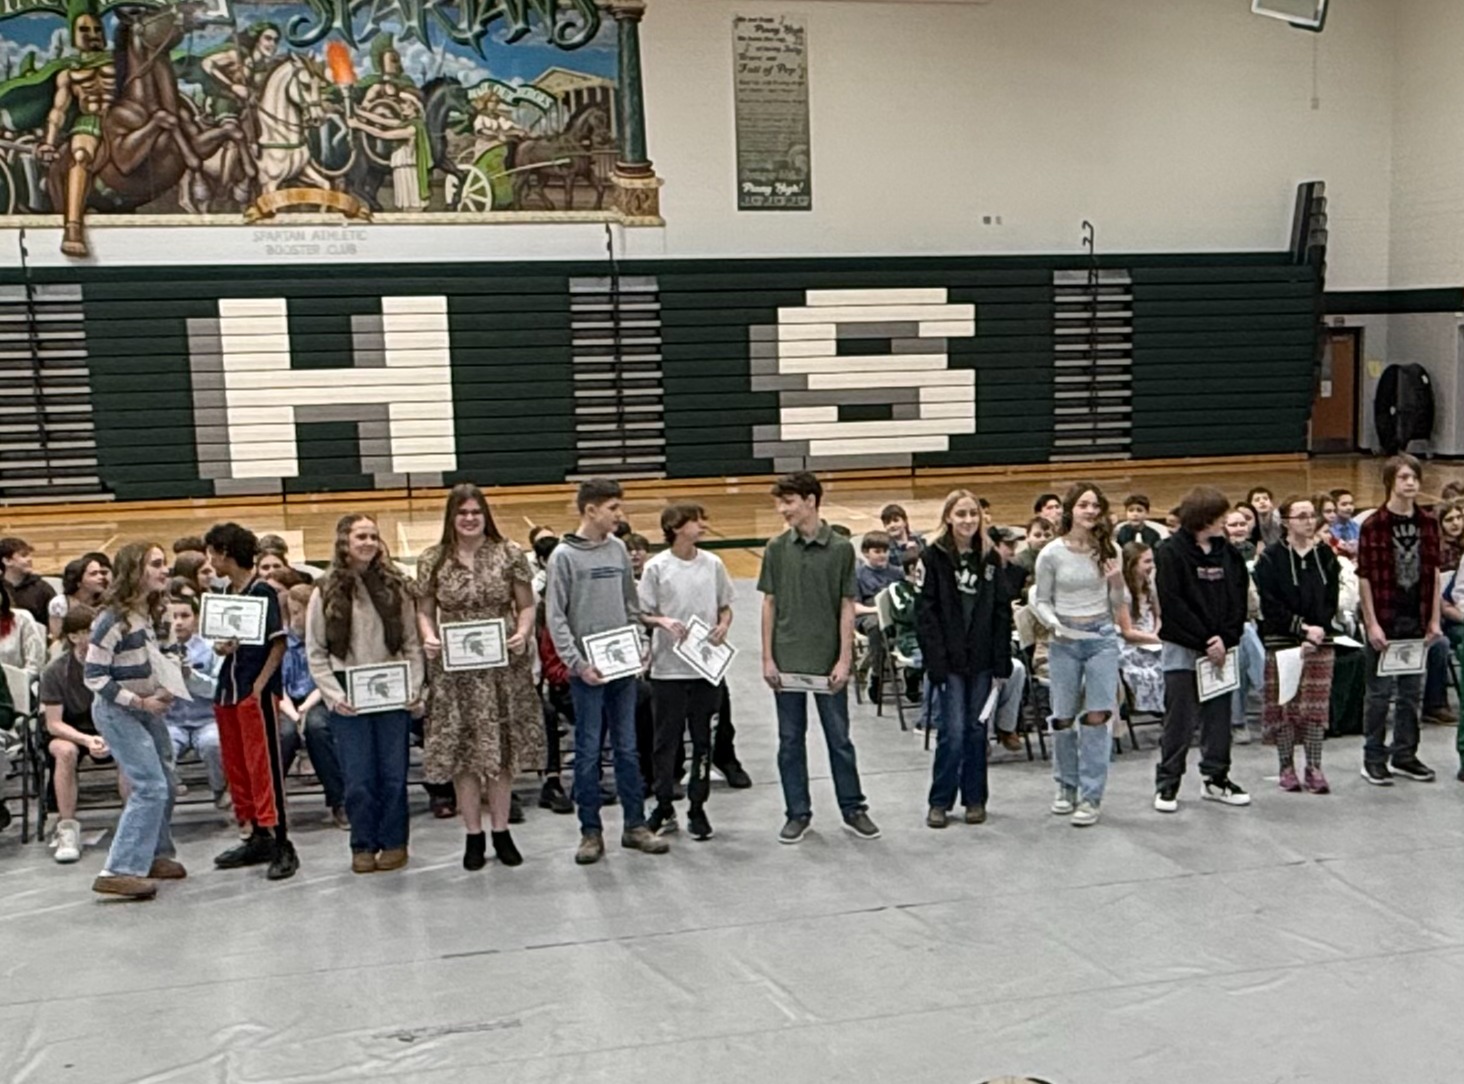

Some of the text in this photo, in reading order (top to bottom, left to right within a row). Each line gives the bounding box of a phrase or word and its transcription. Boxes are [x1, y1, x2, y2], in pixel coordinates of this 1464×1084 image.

[253, 230, 367, 242] SPARTAN ATHLETIC
[265, 244, 357, 255] BOOSTER CLUB
[218, 288, 975, 478] H S
